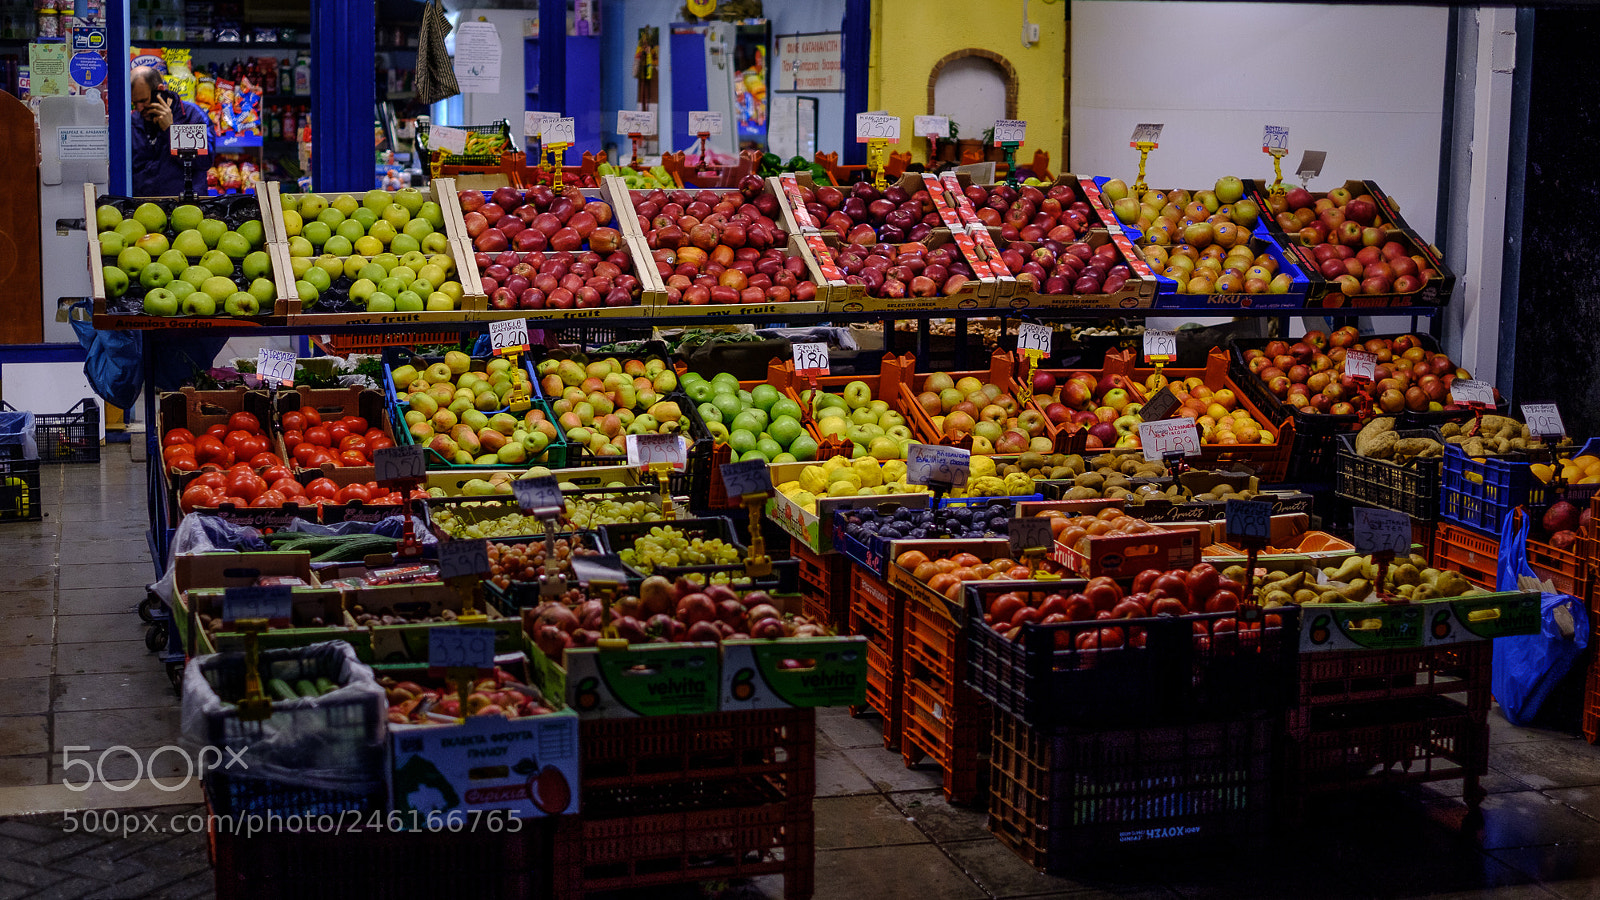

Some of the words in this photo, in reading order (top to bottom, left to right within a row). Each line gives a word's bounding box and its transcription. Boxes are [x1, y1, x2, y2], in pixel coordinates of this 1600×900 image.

[1207, 295, 1240, 304] KIKU
[563, 310, 601, 320] fruit
[741, 305, 776, 314] fruit
[380, 314, 420, 324] fruit
[1167, 506, 1204, 522] Fruits
[1272, 501, 1308, 514] Fruits
[1053, 543, 1075, 571] Fruit
[1494, 608, 1536, 629] velvita
[1375, 624, 1417, 640] velvita
[647, 679, 706, 697] velvita
[801, 671, 857, 689] velvita
